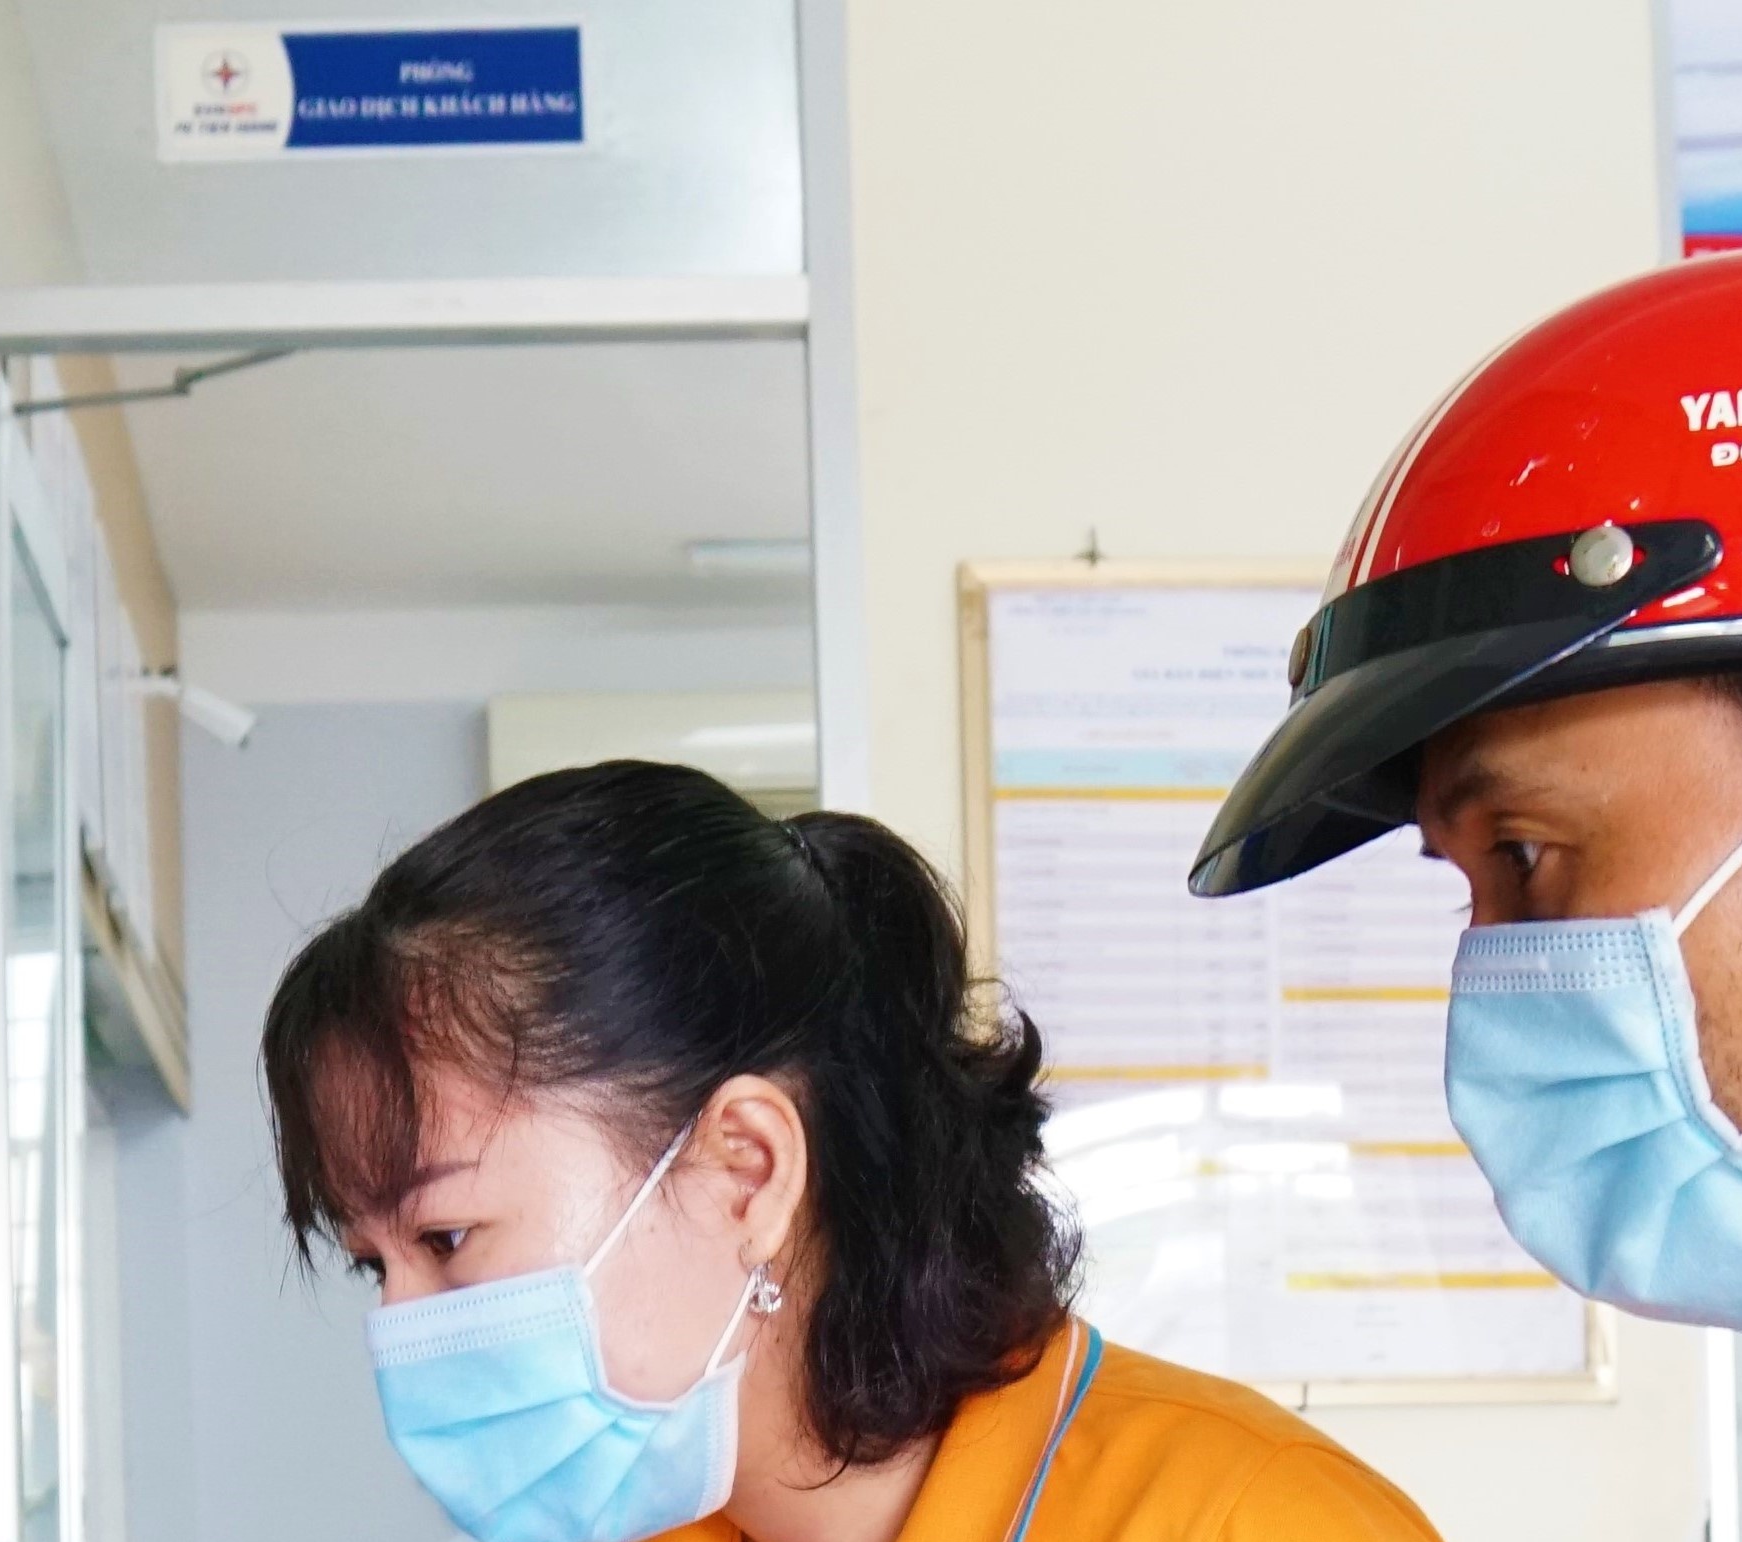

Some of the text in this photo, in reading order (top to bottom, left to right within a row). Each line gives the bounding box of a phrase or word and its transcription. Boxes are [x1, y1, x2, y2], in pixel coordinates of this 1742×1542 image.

[297, 88, 576, 120] GIAO DỊCH KHÁCH HÀNG
